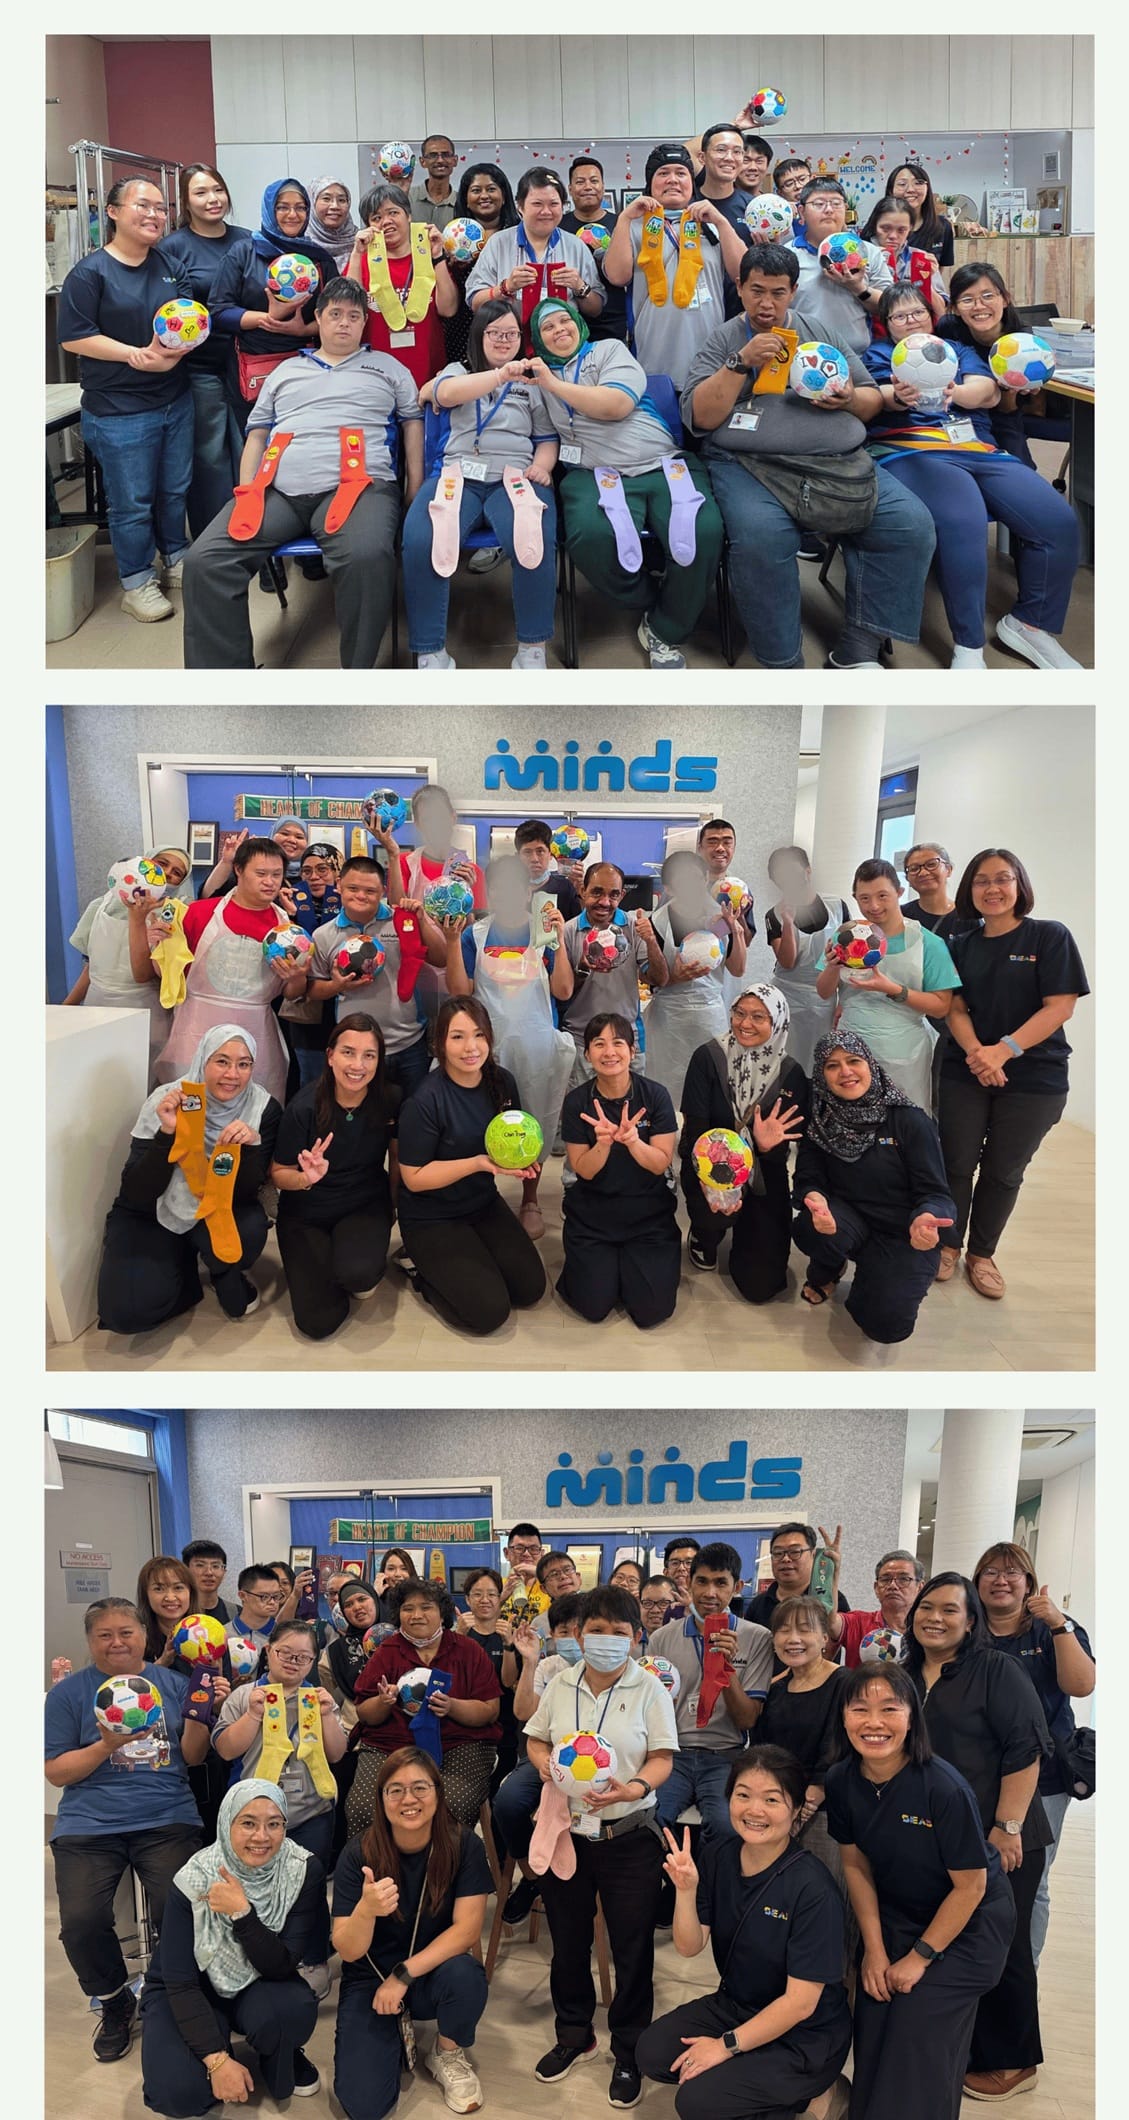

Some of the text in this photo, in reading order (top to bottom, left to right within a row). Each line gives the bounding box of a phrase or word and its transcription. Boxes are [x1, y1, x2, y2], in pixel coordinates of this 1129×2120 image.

[839, 165, 876, 173] WELCOME
[259, 799, 363, 820] HEART OF CHAM
[352, 1523, 475, 1541] HEART OF CHAMPION
[70, 1552, 104, 1561] NO ACCESS
